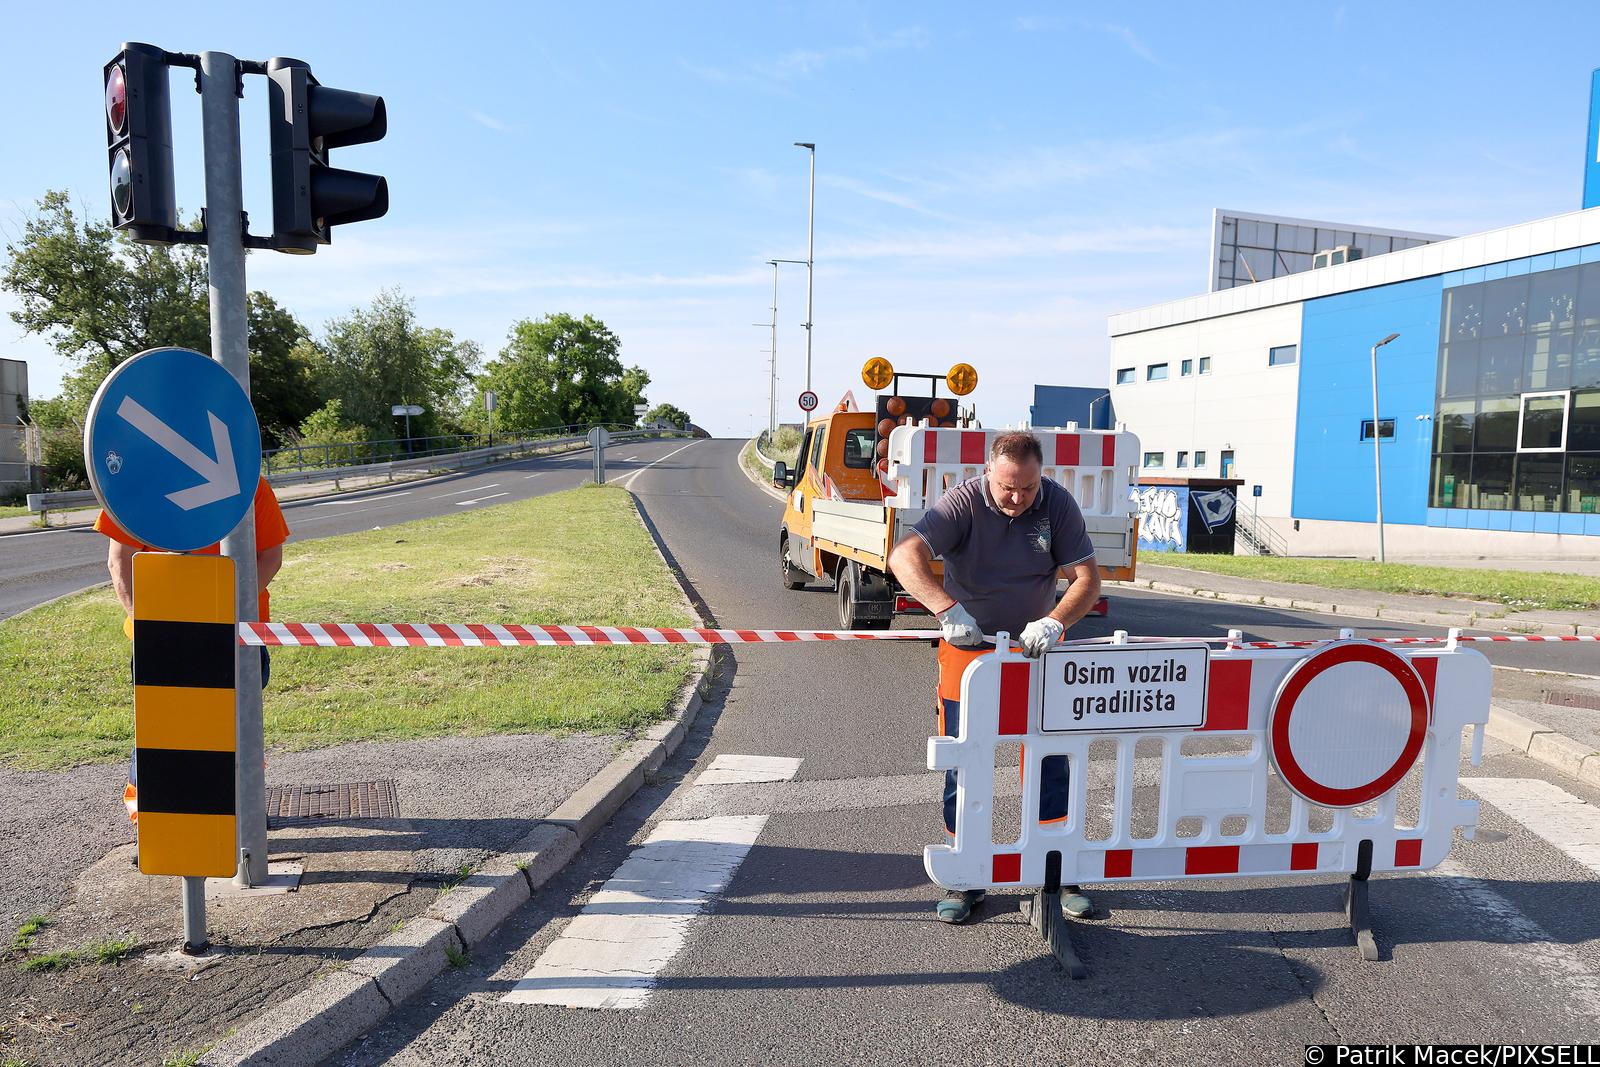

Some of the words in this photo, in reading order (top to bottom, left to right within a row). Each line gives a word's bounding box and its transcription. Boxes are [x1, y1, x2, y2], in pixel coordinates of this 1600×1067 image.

[803, 396, 814, 406] 50
[1064, 660, 1115, 685] Osim
[1128, 658, 1187, 683] vozila
[1072, 688, 1176, 721] gradilišta
